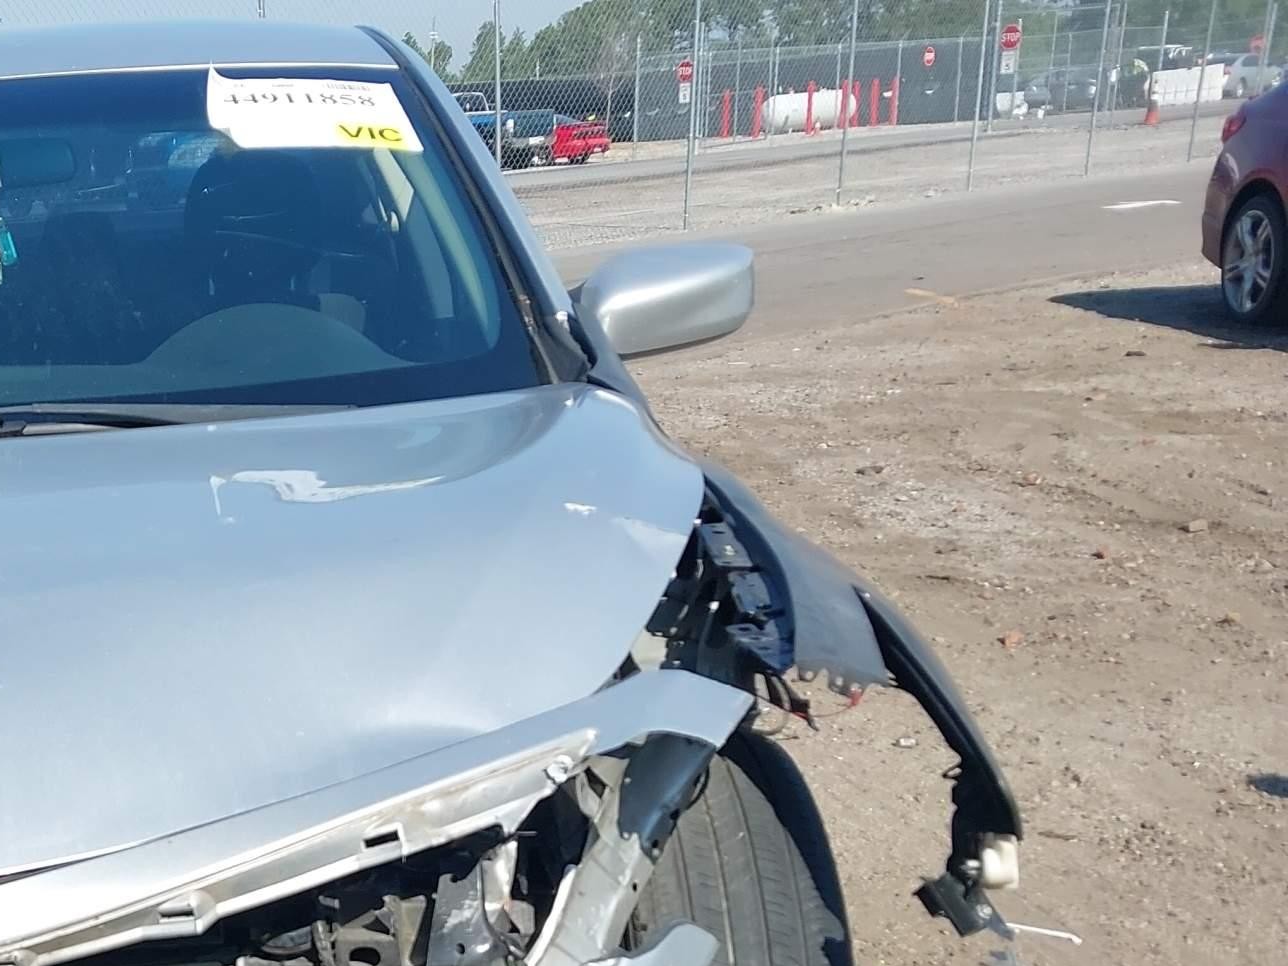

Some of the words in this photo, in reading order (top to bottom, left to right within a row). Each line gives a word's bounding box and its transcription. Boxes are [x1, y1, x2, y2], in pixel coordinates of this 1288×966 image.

[1001, 31, 1021, 42] STOP
[223, 93, 376, 107] 44911858
[338, 124, 403, 142] VIC
